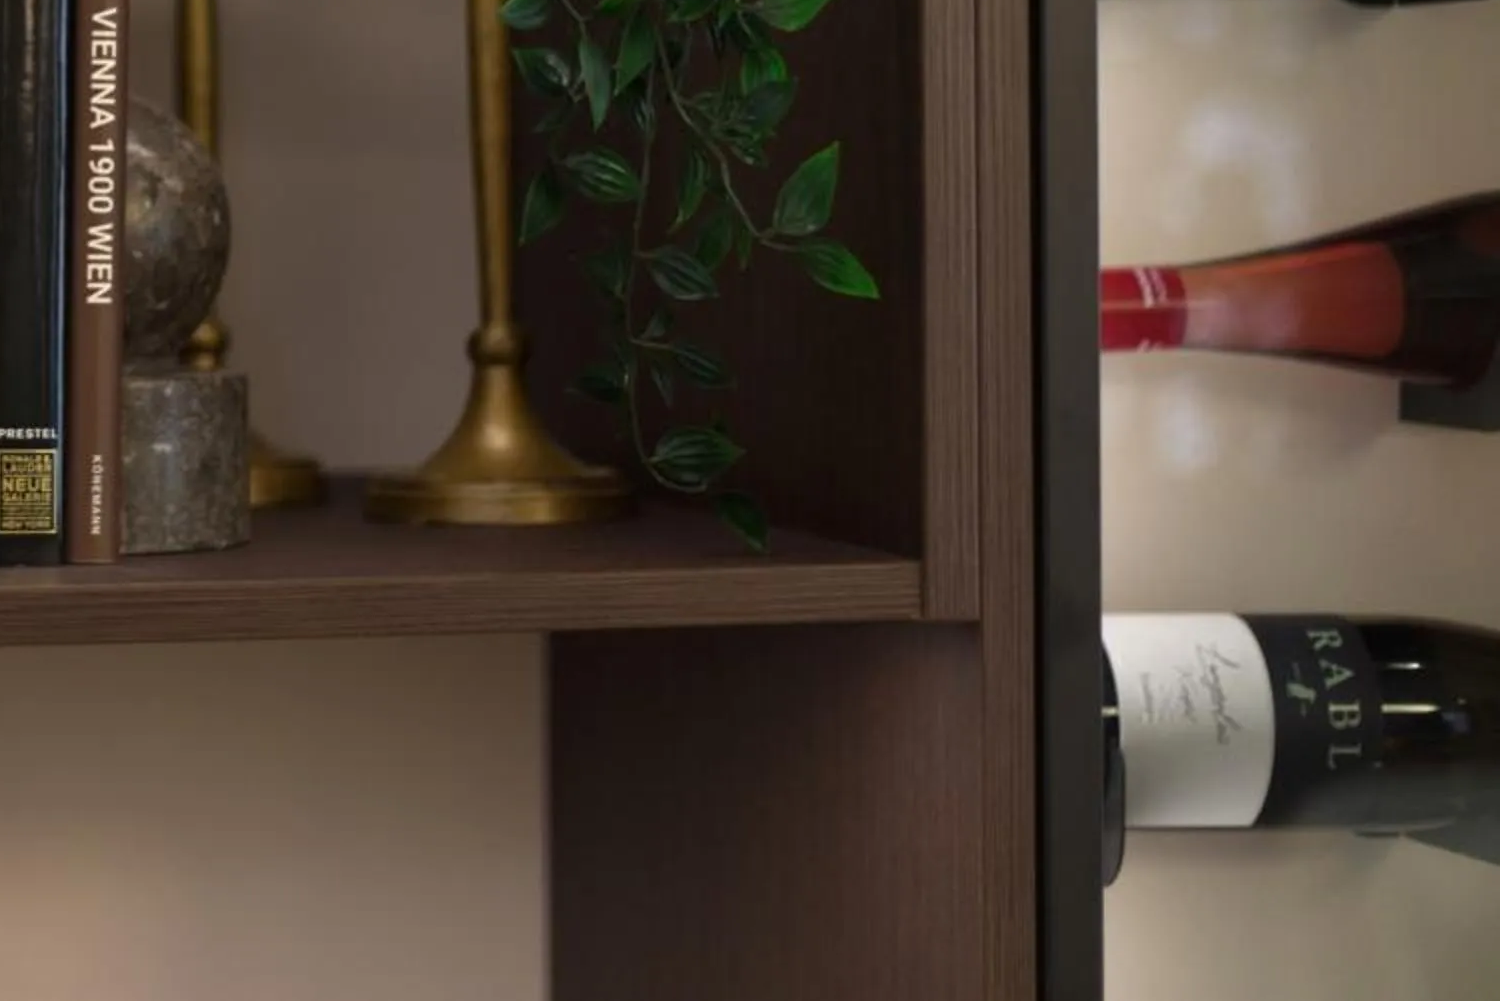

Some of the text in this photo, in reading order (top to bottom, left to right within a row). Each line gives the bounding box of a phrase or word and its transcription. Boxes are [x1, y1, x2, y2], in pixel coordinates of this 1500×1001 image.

[86, 7, 118, 305] VIENNA 1900 WIEN
[3, 476, 53, 492] NEUE
[1306, 628, 1362, 770] RABL
